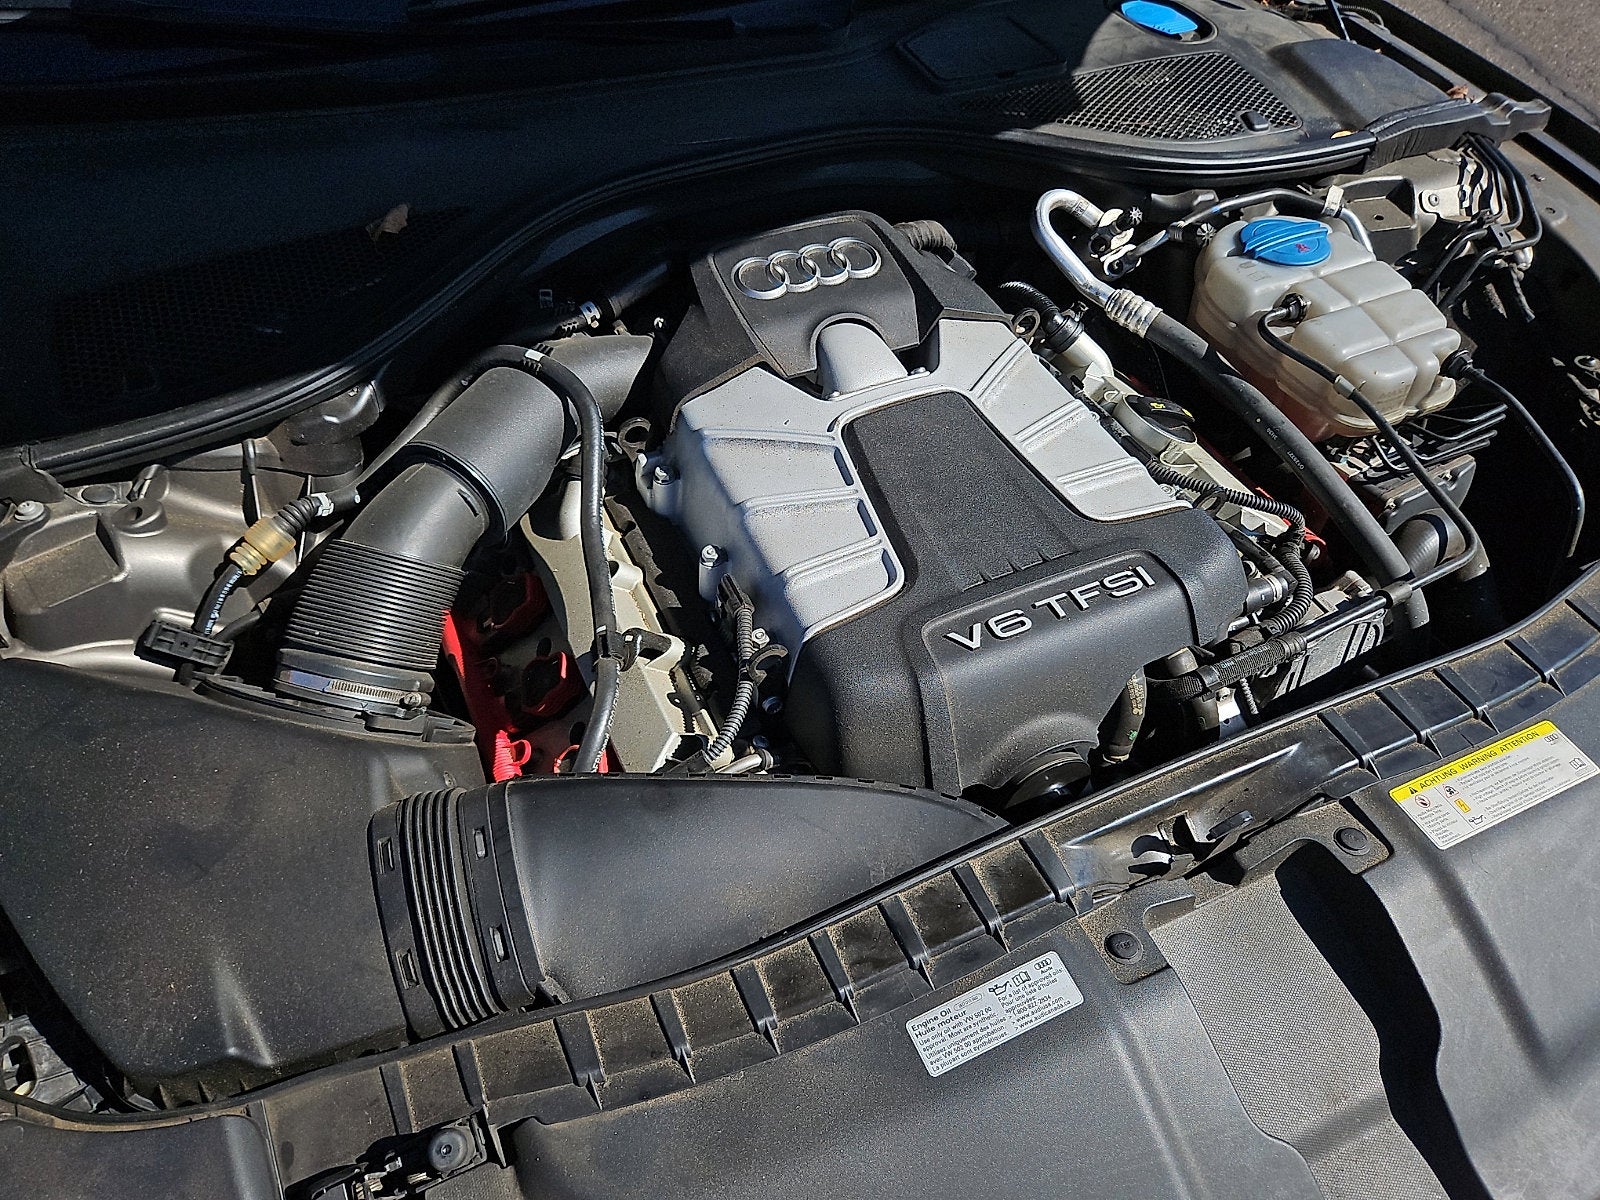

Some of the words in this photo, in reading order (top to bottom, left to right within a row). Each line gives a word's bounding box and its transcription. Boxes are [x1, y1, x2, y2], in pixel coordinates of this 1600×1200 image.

[943, 609, 1033, 650] V6
[1032, 566, 1155, 619] TFSI
[1418, 767, 1457, 788] ACHTUNG
[1458, 749, 1497, 770] WARNING
[1498, 730, 1539, 752] ATTENTION
[997, 994, 1007, 1002] For
[910, 1013, 939, 1032] Engine
[939, 1007, 951, 1017] Oil
[914, 1024, 936, 1039] Huile
[936, 1009, 967, 1028] moteur
[918, 1036, 930, 1046] Use
[929, 1030, 943, 1041] only
[950, 1020, 963, 1030] with
[962, 1014, 974, 1023] VW
[973, 1009, 984, 1018] 502
[947, 1028, 963, 1039] Most
[942, 1049, 953, 1058] VW
